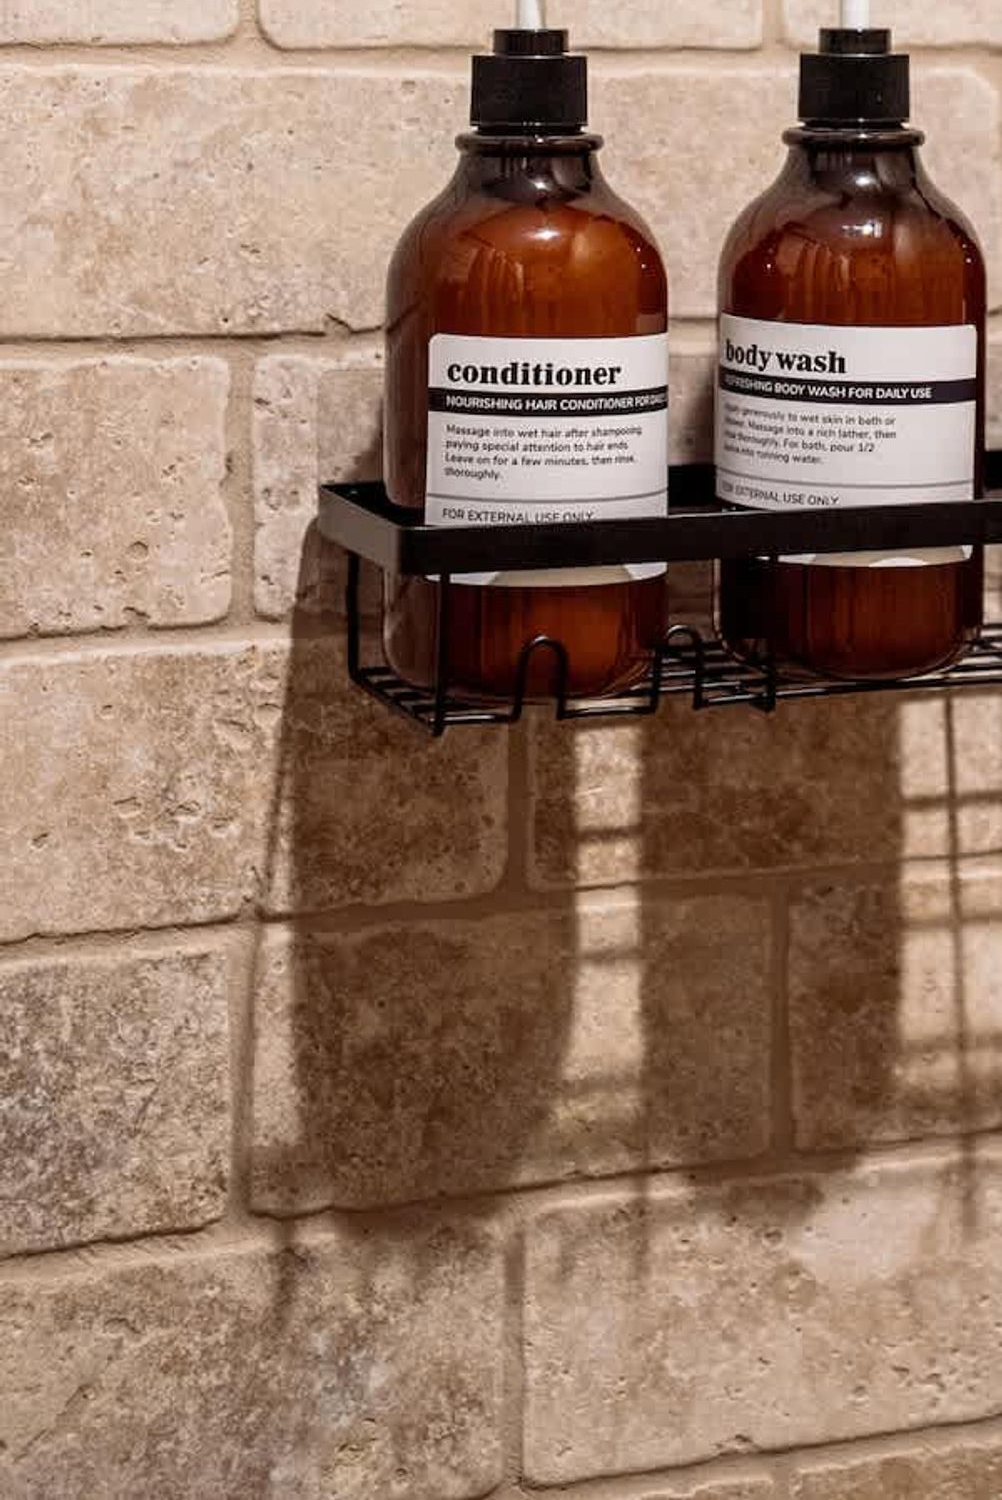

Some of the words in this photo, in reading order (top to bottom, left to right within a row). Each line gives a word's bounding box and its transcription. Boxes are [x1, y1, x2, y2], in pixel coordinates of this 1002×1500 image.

[725, 339, 773, 373] body
[775, 350, 847, 374] wash
[447, 362, 622, 386] conditioner
[724, 374, 772, 392] FRESHING
[774, 382, 805, 396] BODY
[807, 385, 847, 399] WASH
[848, 387, 874, 399] FOR
[875, 388, 909, 400] DAILY
[910, 387, 933, 399] USE
[446, 395, 523, 411] NOURISHING
[525, 399, 558, 411] HAIR
[559, 397, 633, 411] CONDITIONER
[788, 411, 799, 421] to
[800, 413, 820, 423] wet
[822, 414, 843, 424] skin
[845, 414, 856, 424] in
[858, 414, 883, 425] bath
[885, 417, 896, 426] or
[446, 424, 491, 438] Massage
[493, 427, 515, 438] into
[518, 428, 538, 438] wet
[541, 428, 562, 438] hair
[565, 427, 589, 438] after
[748, 420, 784, 436] Massage
[787, 425, 805, 437] into
[816, 428, 837, 438] rich
[874, 429, 897, 439] then
[446, 440, 479, 452] paying
[482, 442, 519, 452] special
[522, 442, 571, 453] attention
[574, 442, 584, 452] to
[586, 441, 605, 451] hair
[783, 437, 799, 449] For
[830, 442, 855, 453] pour
[858, 442, 876, 453] 1/2
[445, 452, 474, 463] Leave
[493, 455, 509, 466] for
[511, 458, 518, 466] a
[521, 456, 541, 466] few
[592, 455, 612, 465] then
[783, 491, 805, 505] USE
[807, 494, 840, 506] ONLY
[442, 508, 465, 520] FOR
[467, 509, 529, 522] EXTERNAL
[534, 512, 561, 523] USE
[562, 512, 594, 522] ONLY
